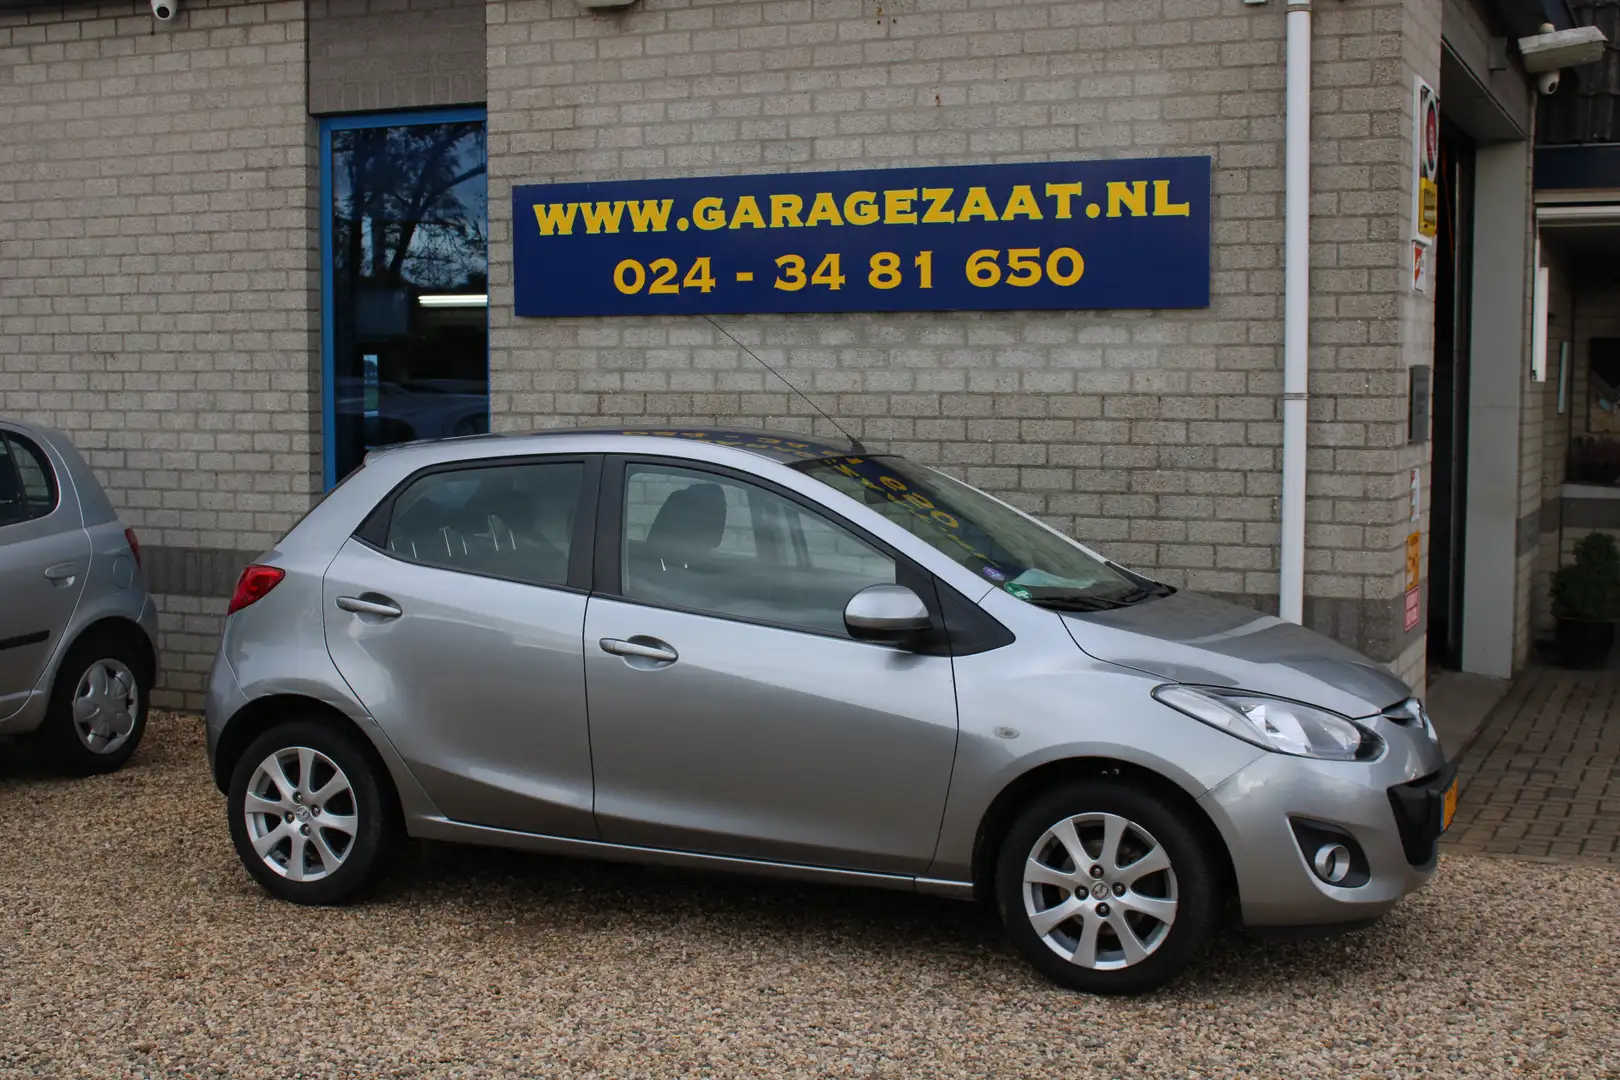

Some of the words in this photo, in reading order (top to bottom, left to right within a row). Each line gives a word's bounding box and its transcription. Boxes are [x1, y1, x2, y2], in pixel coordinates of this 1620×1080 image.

[533, 179, 1191, 236] WWW.GARAGEZAAT.NL
[613, 256, 716, 295] 024
[735, 271, 754, 282] -
[774, 253, 846, 291] 34
[867, 250, 933, 290] 81
[965, 247, 1085, 288] 650
